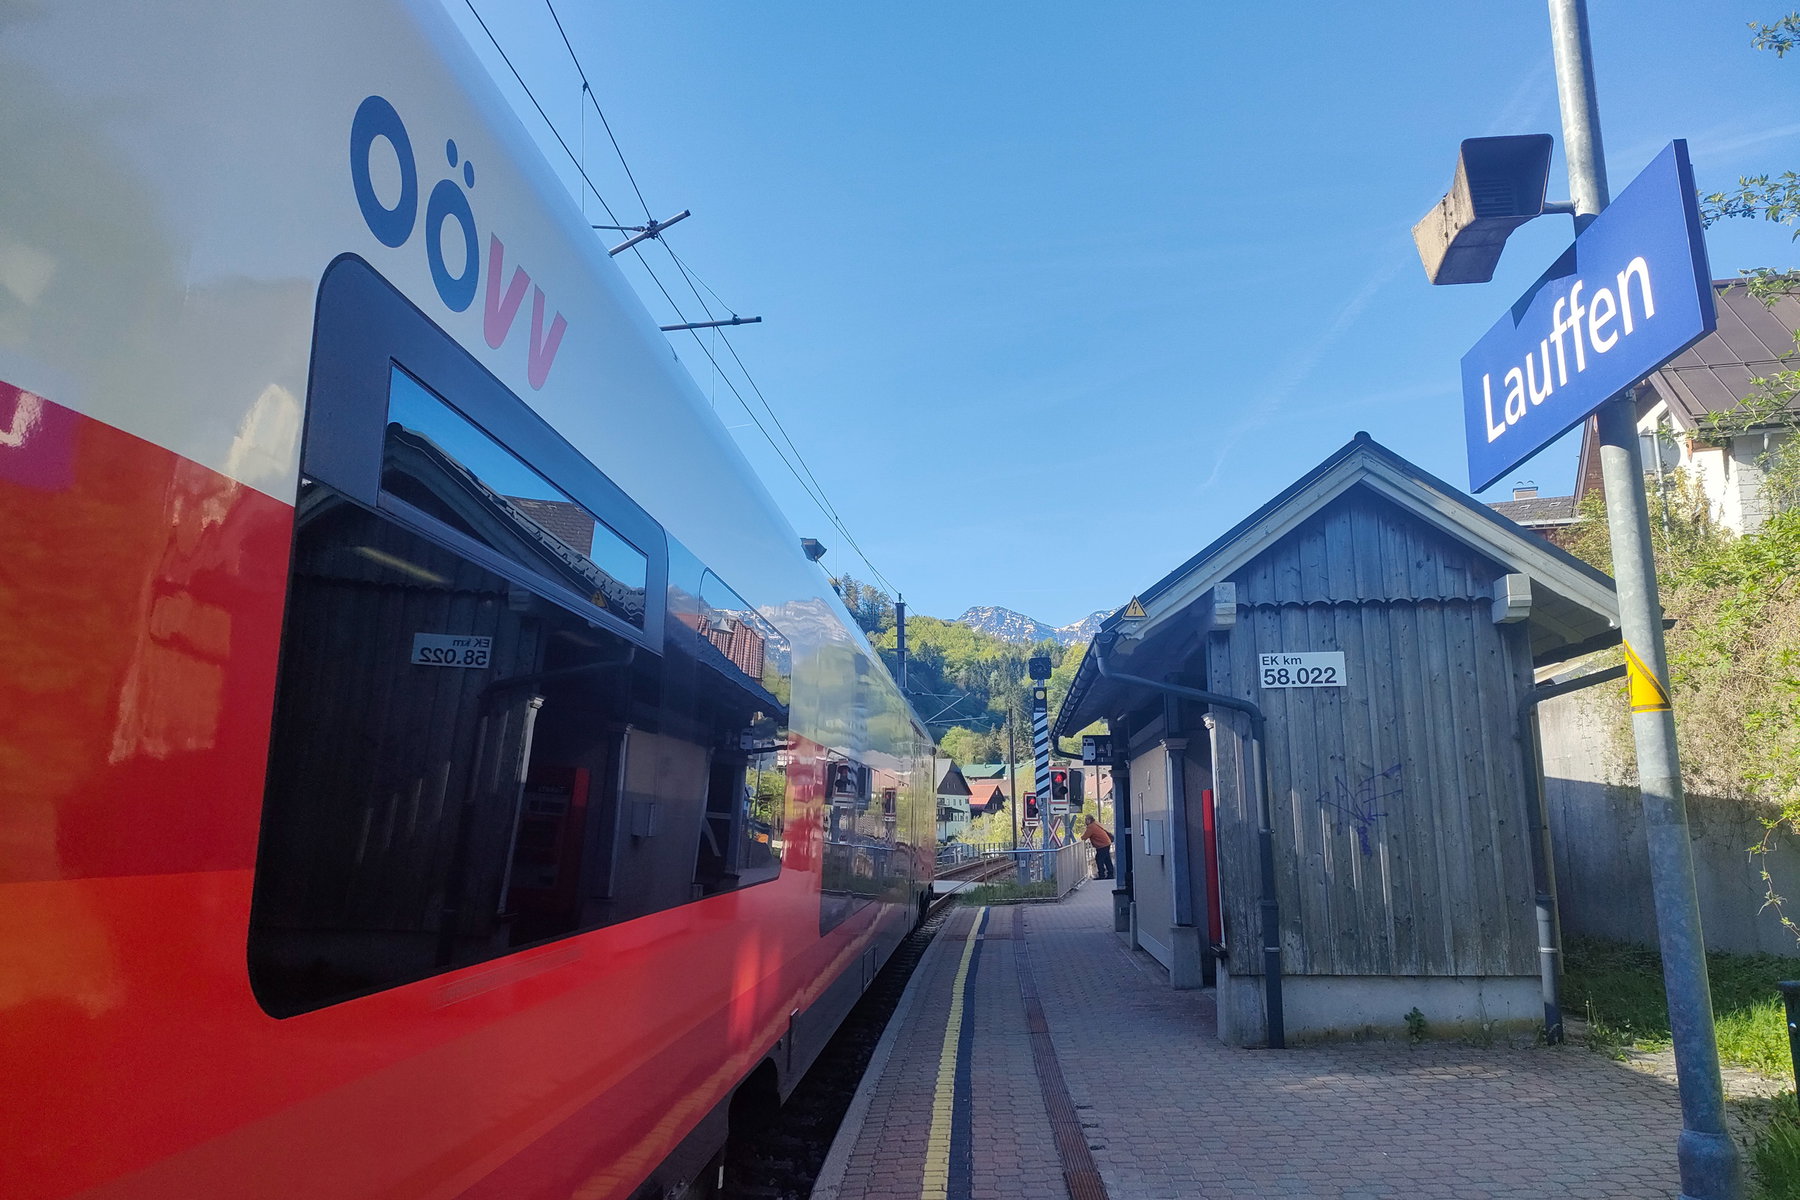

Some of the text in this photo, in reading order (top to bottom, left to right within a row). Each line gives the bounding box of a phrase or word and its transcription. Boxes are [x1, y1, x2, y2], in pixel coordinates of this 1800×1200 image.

[350, 95, 568, 391] OÖVV
[1482, 256, 1655, 444] Lauffen
[1262, 655, 1302, 665] EK km
[1264, 667, 1337, 685] 58.022
